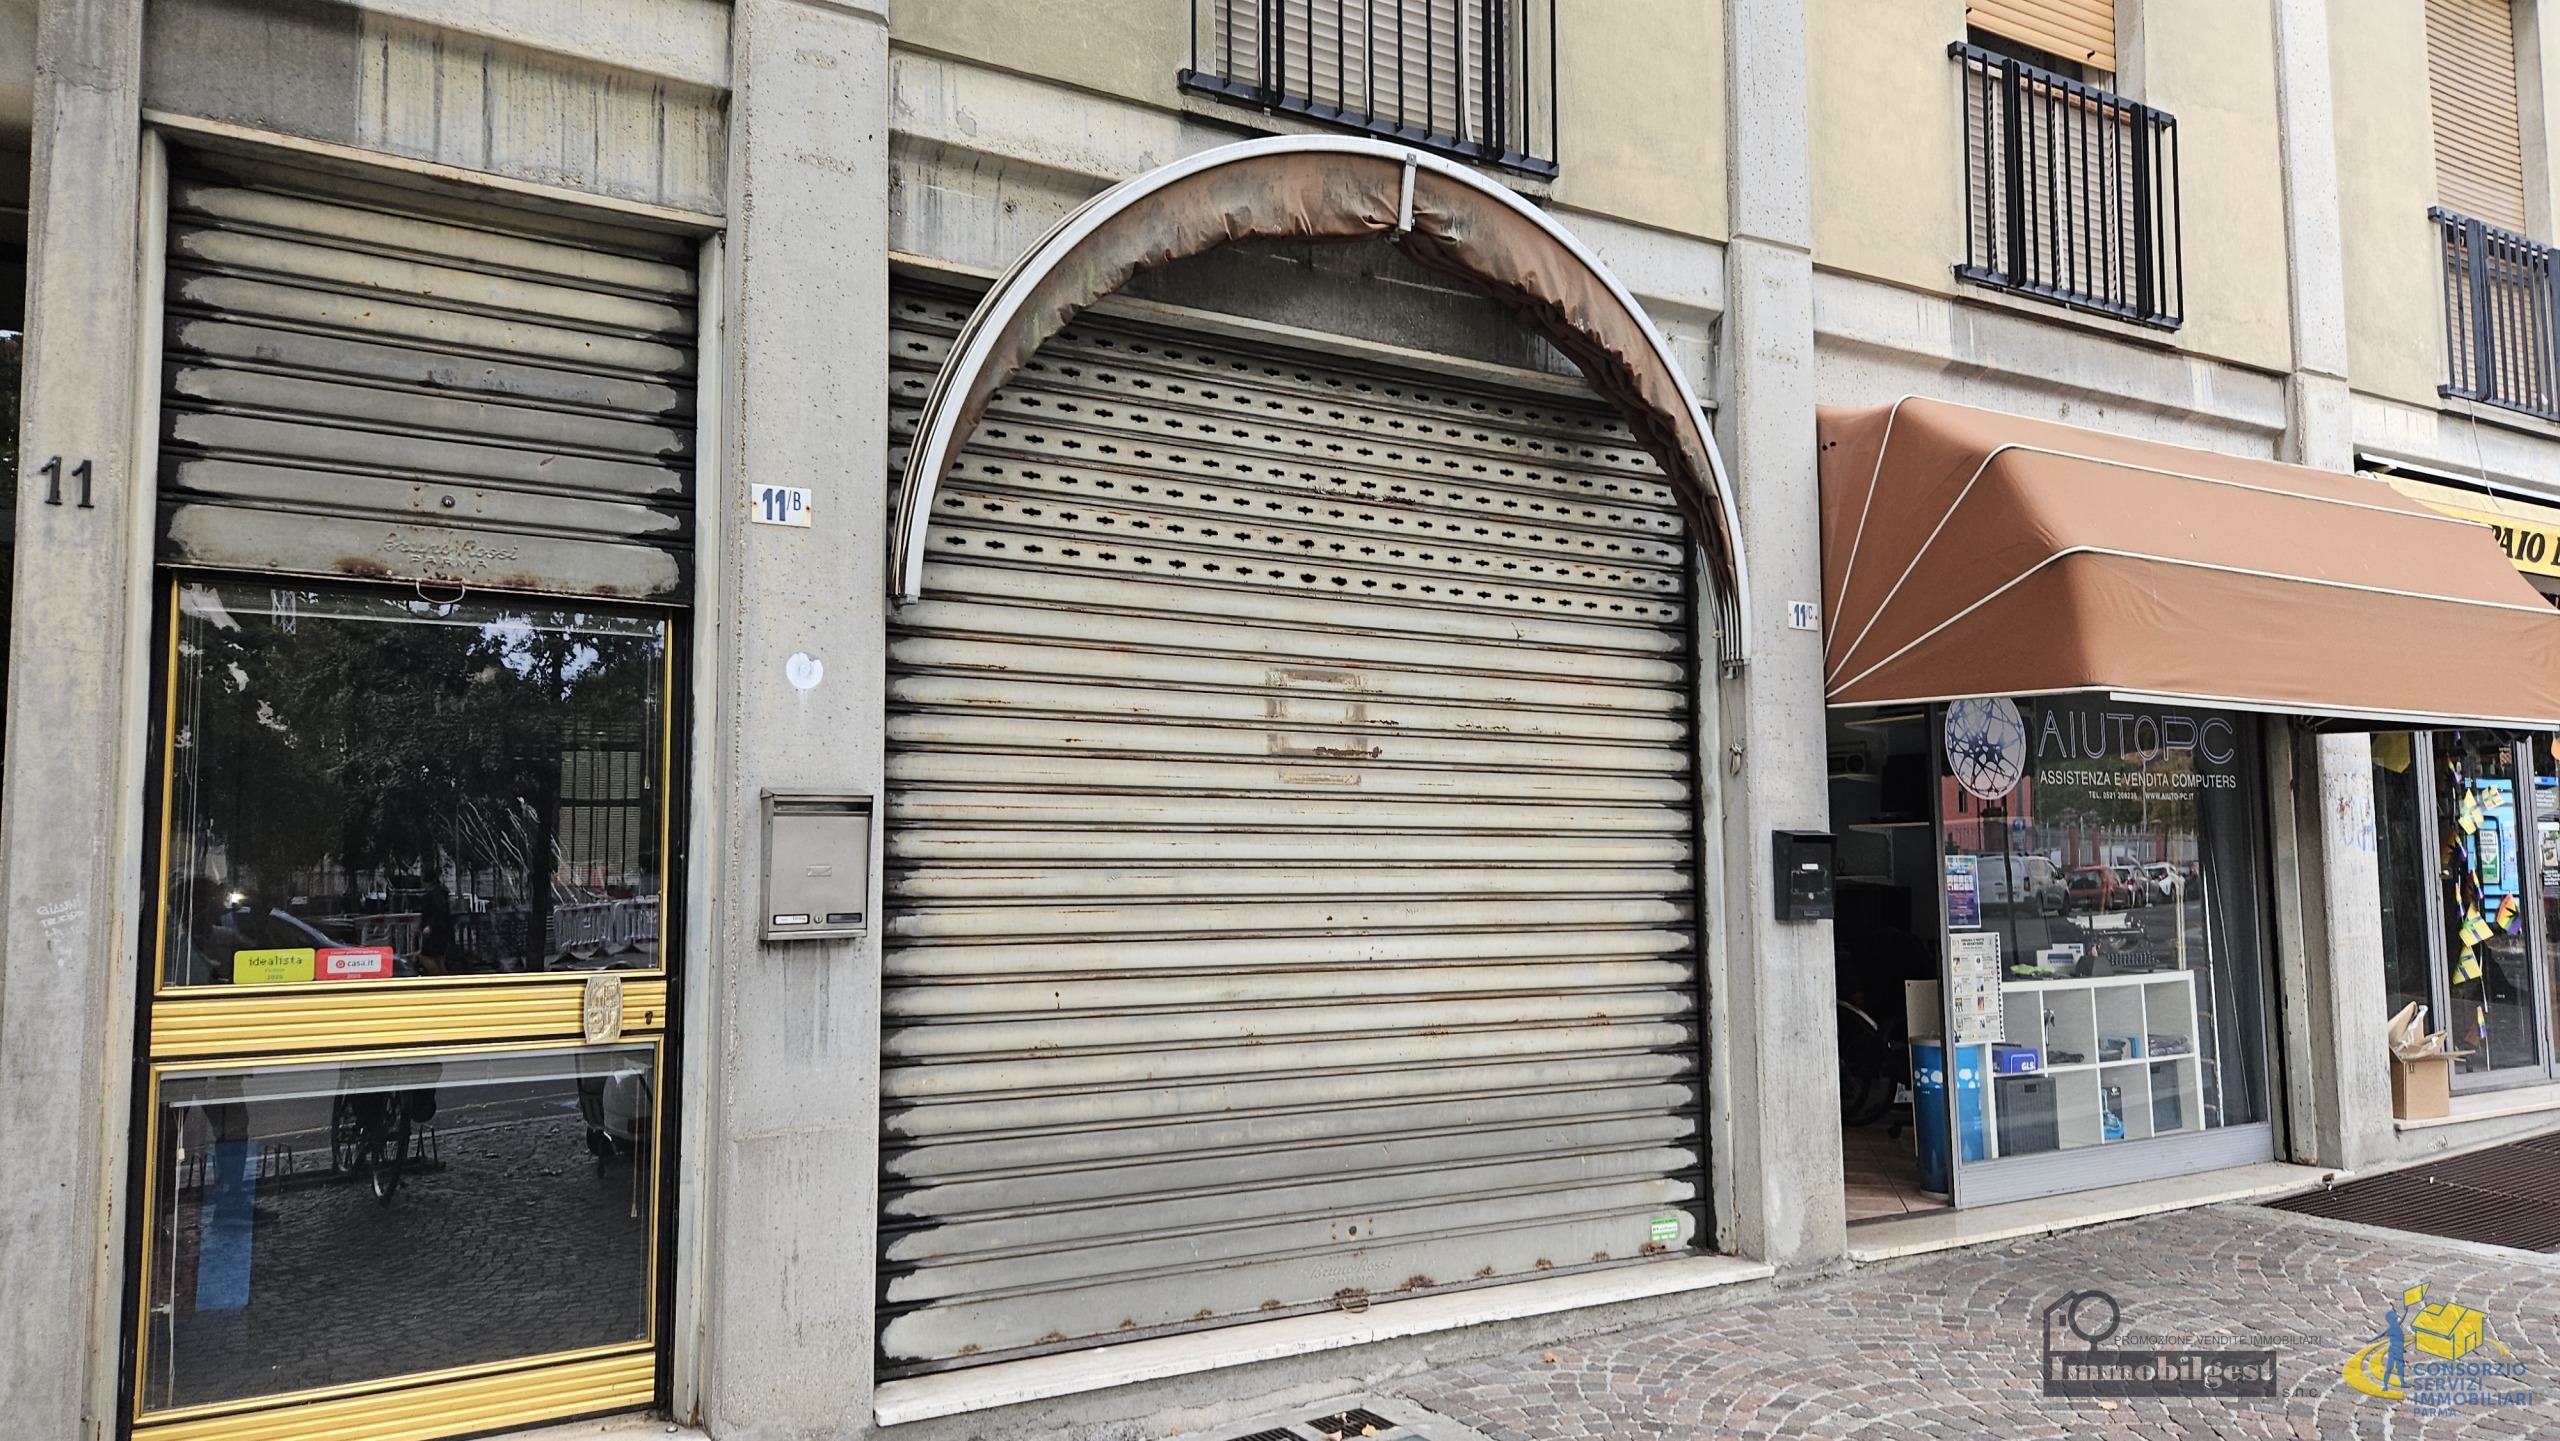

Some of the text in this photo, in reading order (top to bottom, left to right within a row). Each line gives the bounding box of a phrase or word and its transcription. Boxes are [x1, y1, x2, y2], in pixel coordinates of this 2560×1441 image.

[41, 455, 95, 509] 11
[762, 488, 801, 521] 11/B
[2040, 770, 2236, 789] ASSISTENZA E VENDITA COMPUTERS
[2088, 791, 2101, 800] TEL.
[2102, 791, 2116, 800] 0521
[2145, 792, 2194, 801] WWW.AIUTO-PC.IT
[249, 956, 303, 967] idealista
[347, 959, 374, 967] casa.it
